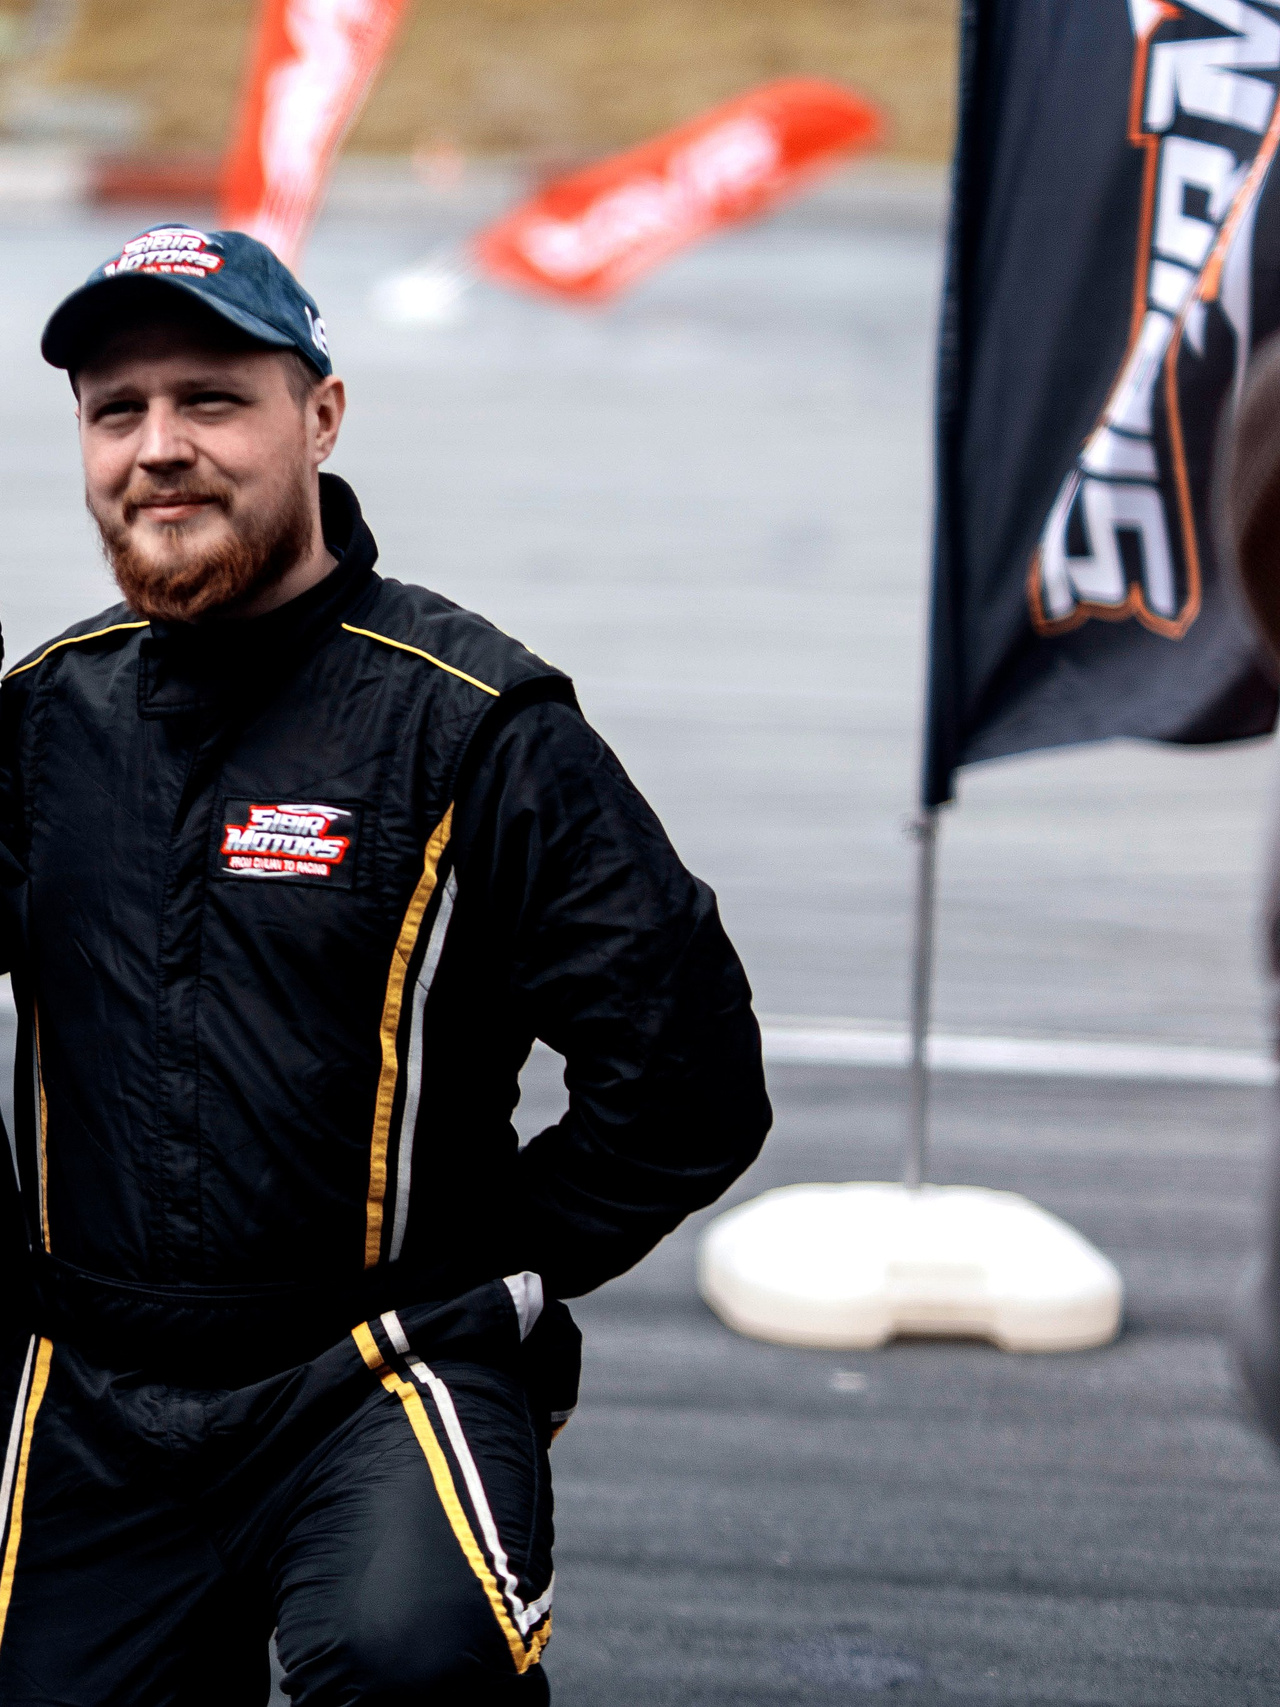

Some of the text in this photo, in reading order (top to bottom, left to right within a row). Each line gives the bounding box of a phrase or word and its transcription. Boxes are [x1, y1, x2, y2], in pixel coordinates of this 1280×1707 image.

[124, 234, 202, 255] SIBIR
[104, 249, 221, 278] MOTORS
[248, 808, 327, 836] SIBIR
[225, 827, 345, 859] MOTORS
